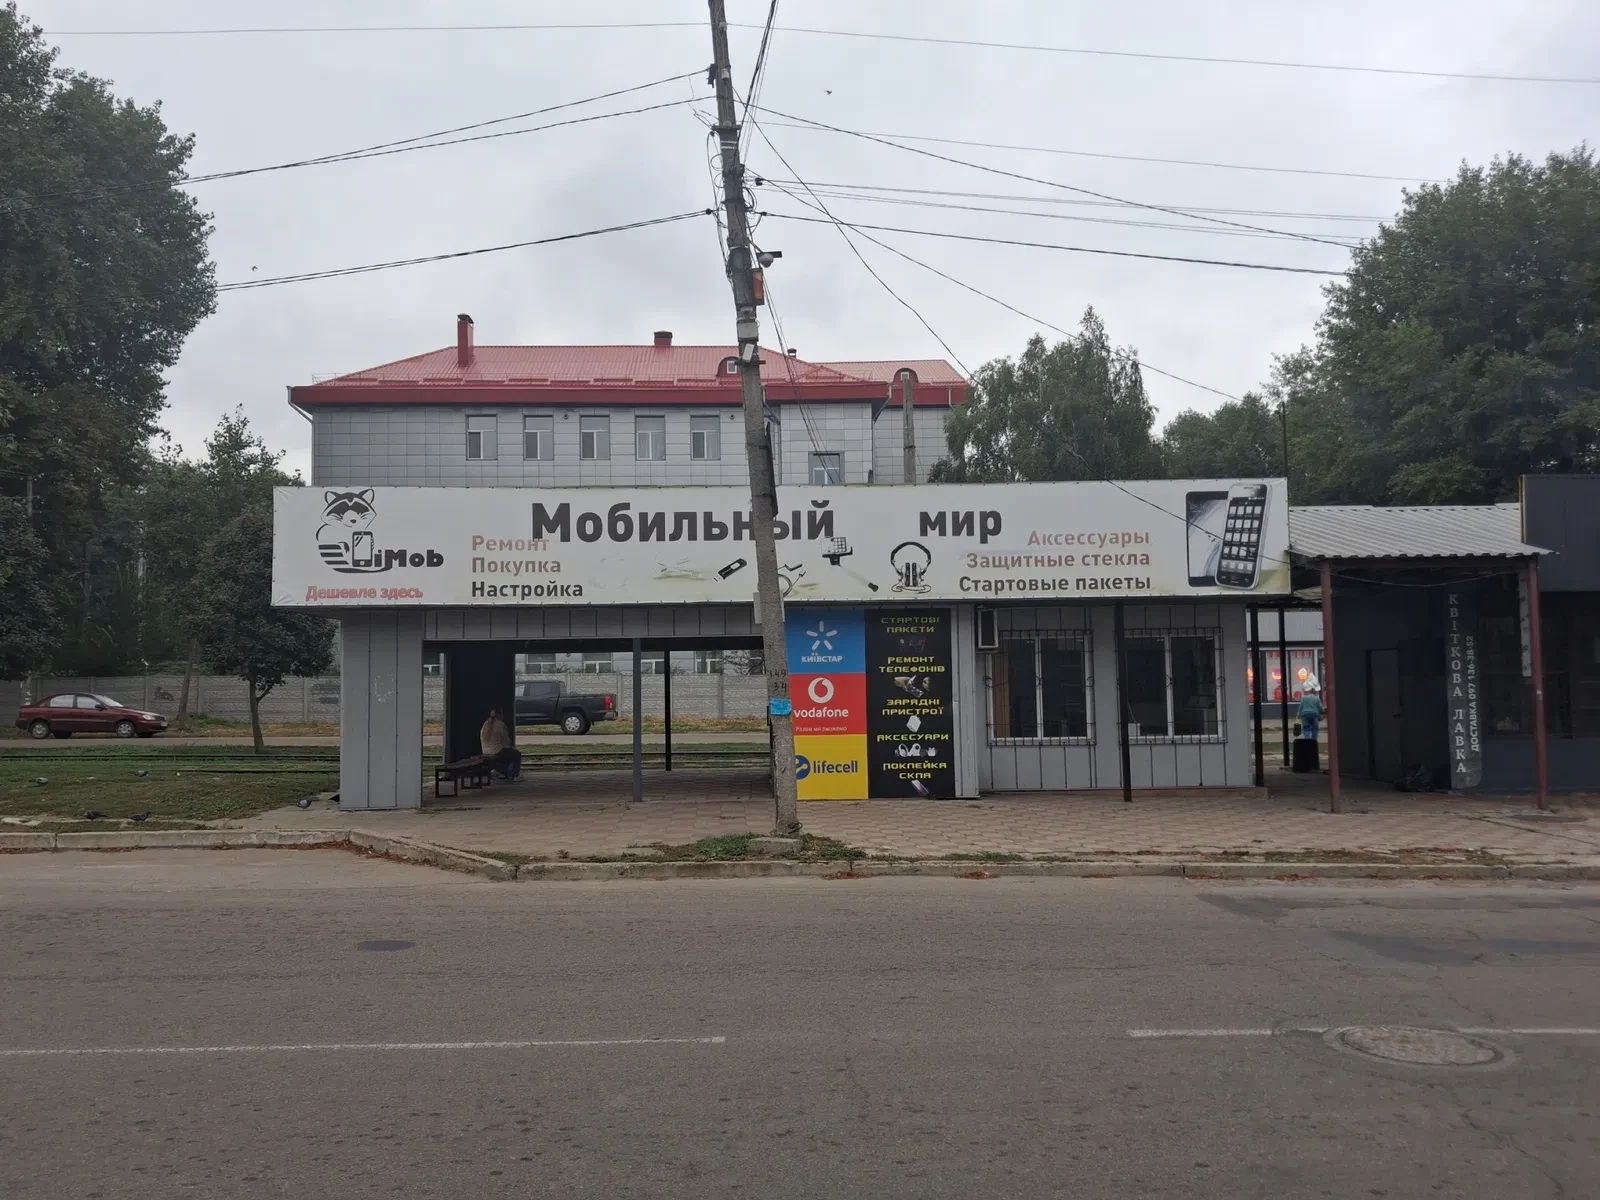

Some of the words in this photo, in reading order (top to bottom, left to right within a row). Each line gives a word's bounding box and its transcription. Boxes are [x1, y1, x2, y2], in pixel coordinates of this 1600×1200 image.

[532, 501, 834, 542] Мобильный
[919, 510, 1003, 544] мир
[472, 535, 550, 551] Ремонт
[1027, 530, 1150, 549] Аксессуары
[374, 549, 444, 568] iMob
[472, 557, 561, 577] Покупка
[966, 552, 1075, 570] Защитные
[1081, 551, 1150, 567] стекла
[306, 586, 377, 601] Дешевле
[380, 587, 424, 600] здесь
[472, 581, 583, 600] Настройка
[959, 576, 1069, 596] Стартовые
[1076, 575, 1151, 591] пакеты
[886, 626, 935, 634] ПАКЕТИ
[1448, 594, 1463, 697] КВІТКОВА
[887, 656, 935, 665] РЕМОНТ
[1468, 683, 1477, 700] 097
[793, 707, 849, 719] vodafone
[882, 706, 944, 716] ПРИСТРОЇ
[1469, 702, 1480, 751] ДОСТАВКА
[877, 734, 949, 742] АКСЕСУАРИ
[1453, 709, 1467, 773] ЛАВКА
[813, 760, 858, 774] lifecell
